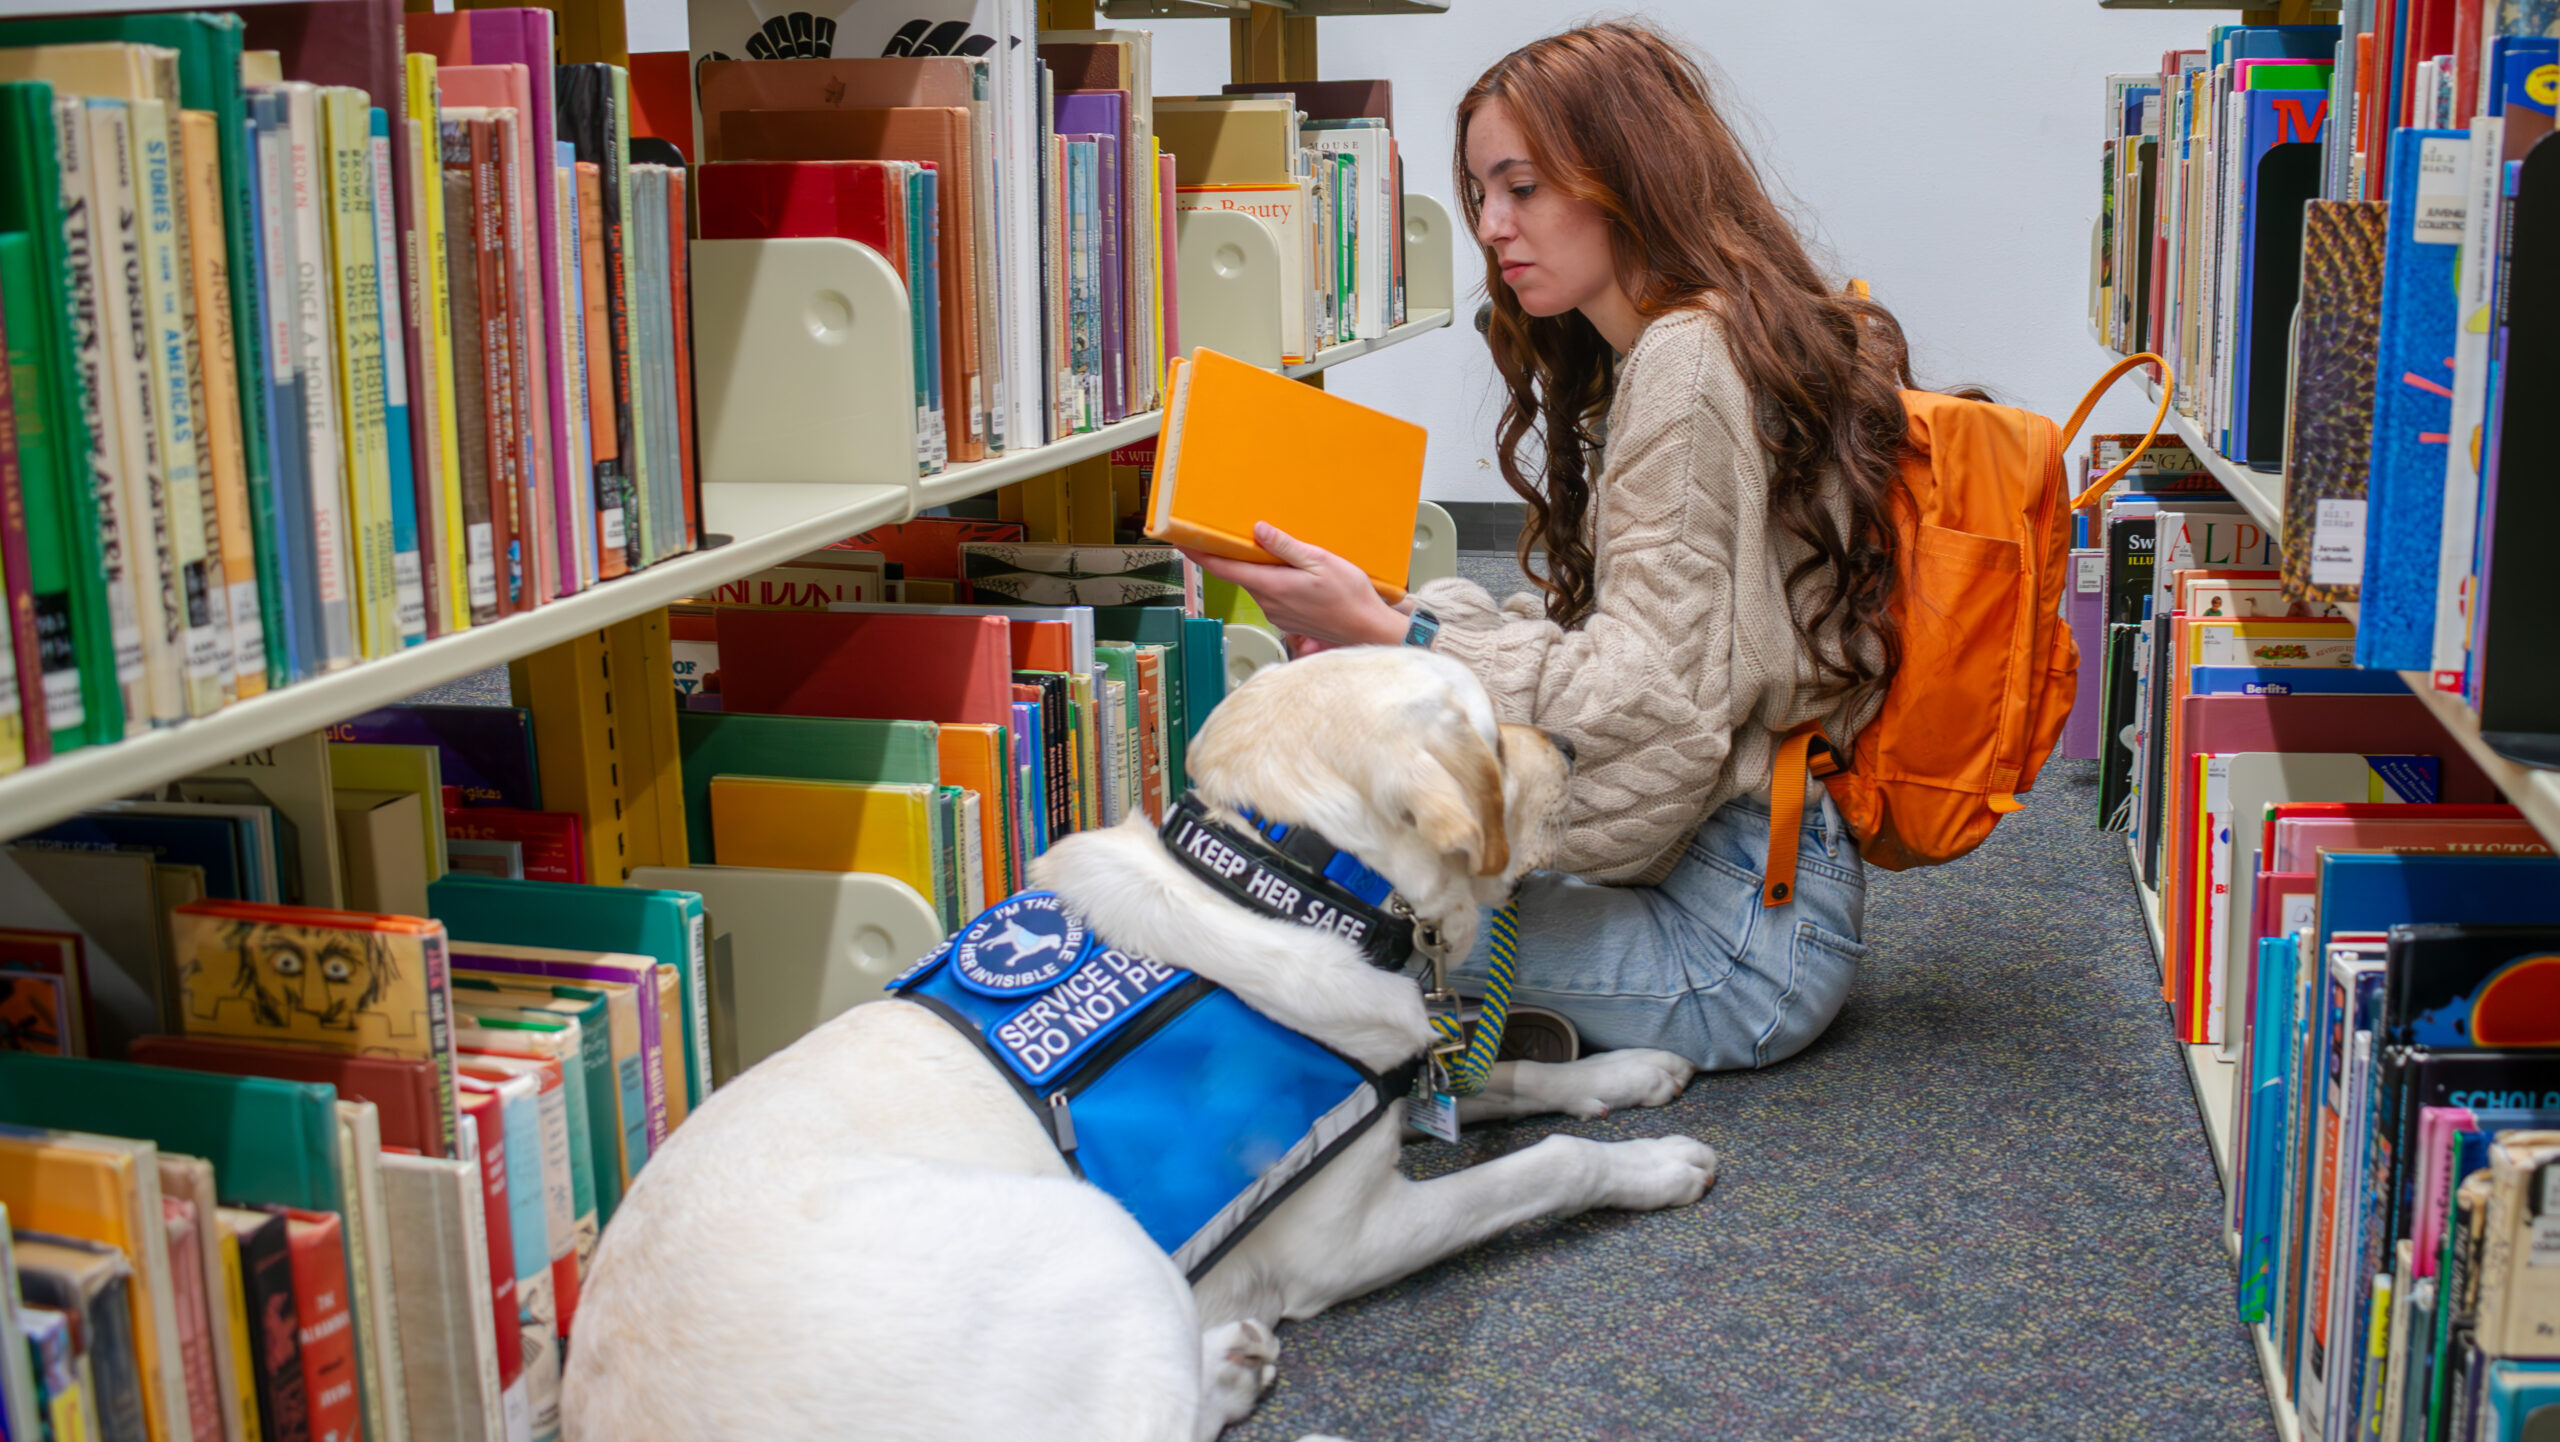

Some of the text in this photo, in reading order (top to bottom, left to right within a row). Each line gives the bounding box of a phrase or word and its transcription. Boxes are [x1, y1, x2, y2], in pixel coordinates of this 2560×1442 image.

[146, 141, 172, 234] STORIES
[164, 329, 192, 443] AMERICAS
[298, 262, 316, 322] ONCE
[2128, 556, 2155, 566] ILLU
[672, 660, 698, 675] OF
[2245, 683, 2288, 695] Berlitz
[1176, 820, 1367, 945] I KEEP HER SAFE
[960, 896, 1084, 987] I'M THE VISIBLE TO HER INVISIBLE
[432, 993, 447, 1020] and
[998, 961, 1104, 1049] SERVICE
[1018, 955, 1176, 1074] DO NOT PE
[434, 1023, 450, 1048] the
